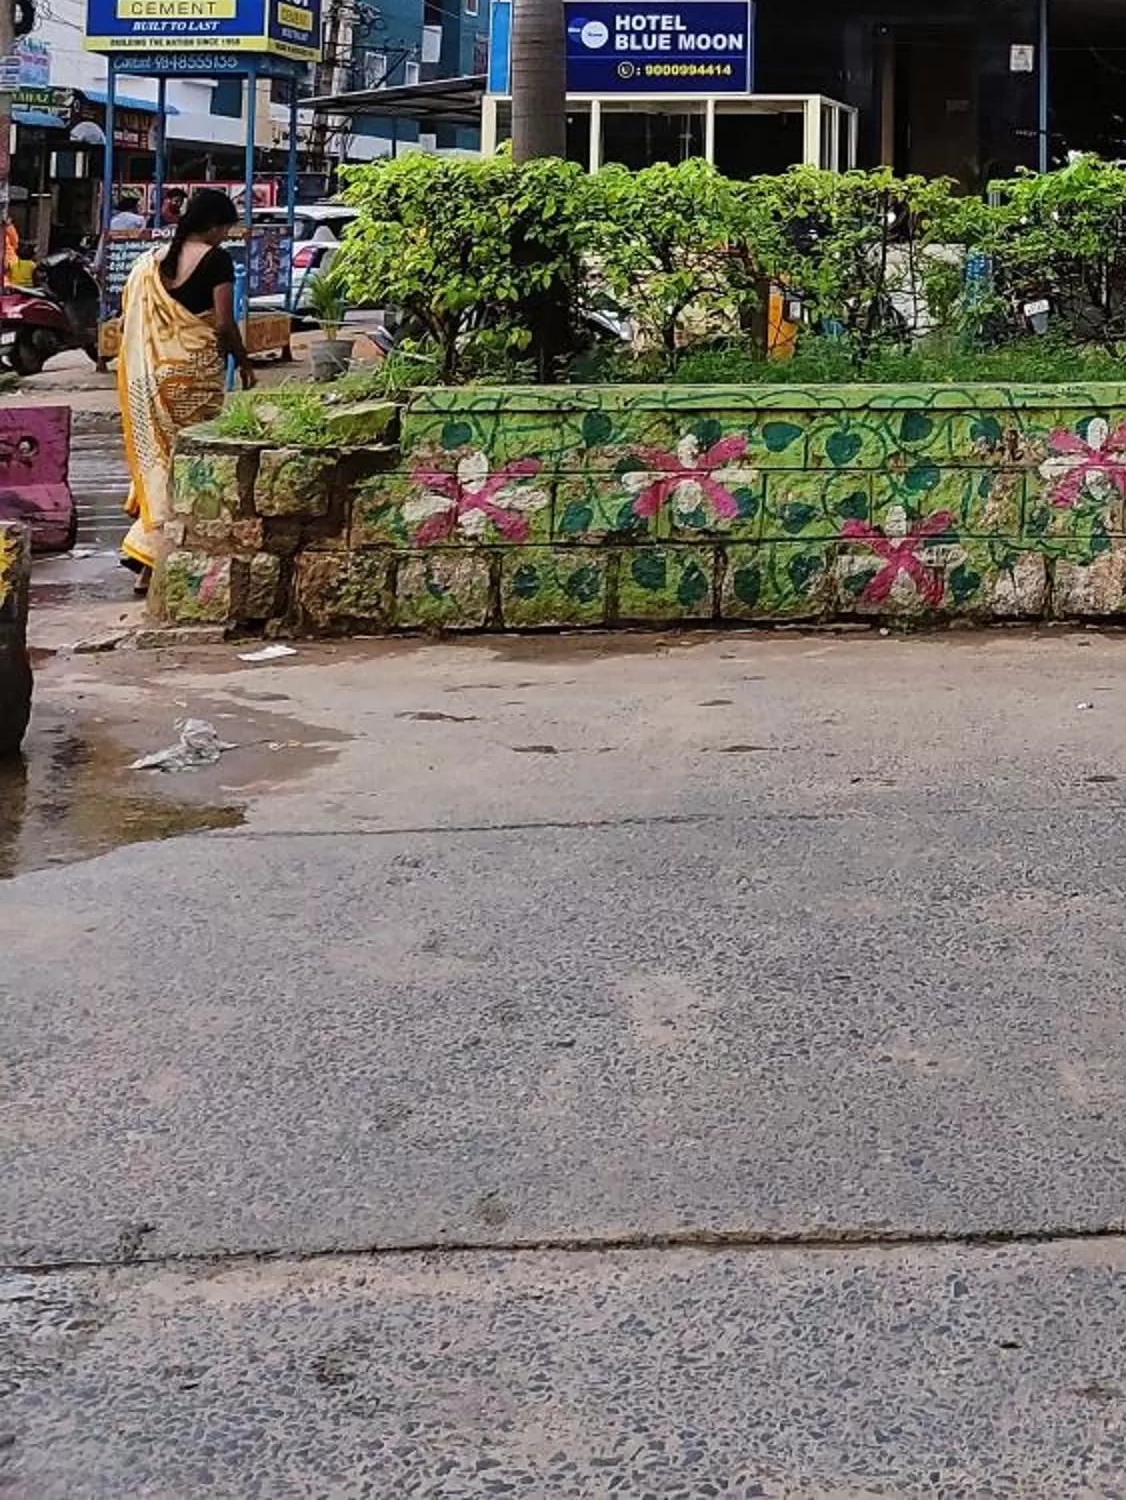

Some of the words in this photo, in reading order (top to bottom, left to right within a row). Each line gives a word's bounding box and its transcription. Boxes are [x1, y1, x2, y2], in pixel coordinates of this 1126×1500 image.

[131, 1, 217, 15] CEMENT
[132, 21, 167, 31] BUILT
[168, 21, 187, 31] TO
[188, 21, 220, 31] LAST
[615, 14, 687, 31] HOTEL
[615, 34, 671, 50] BLUE
[678, 34, 744, 50] MOON
